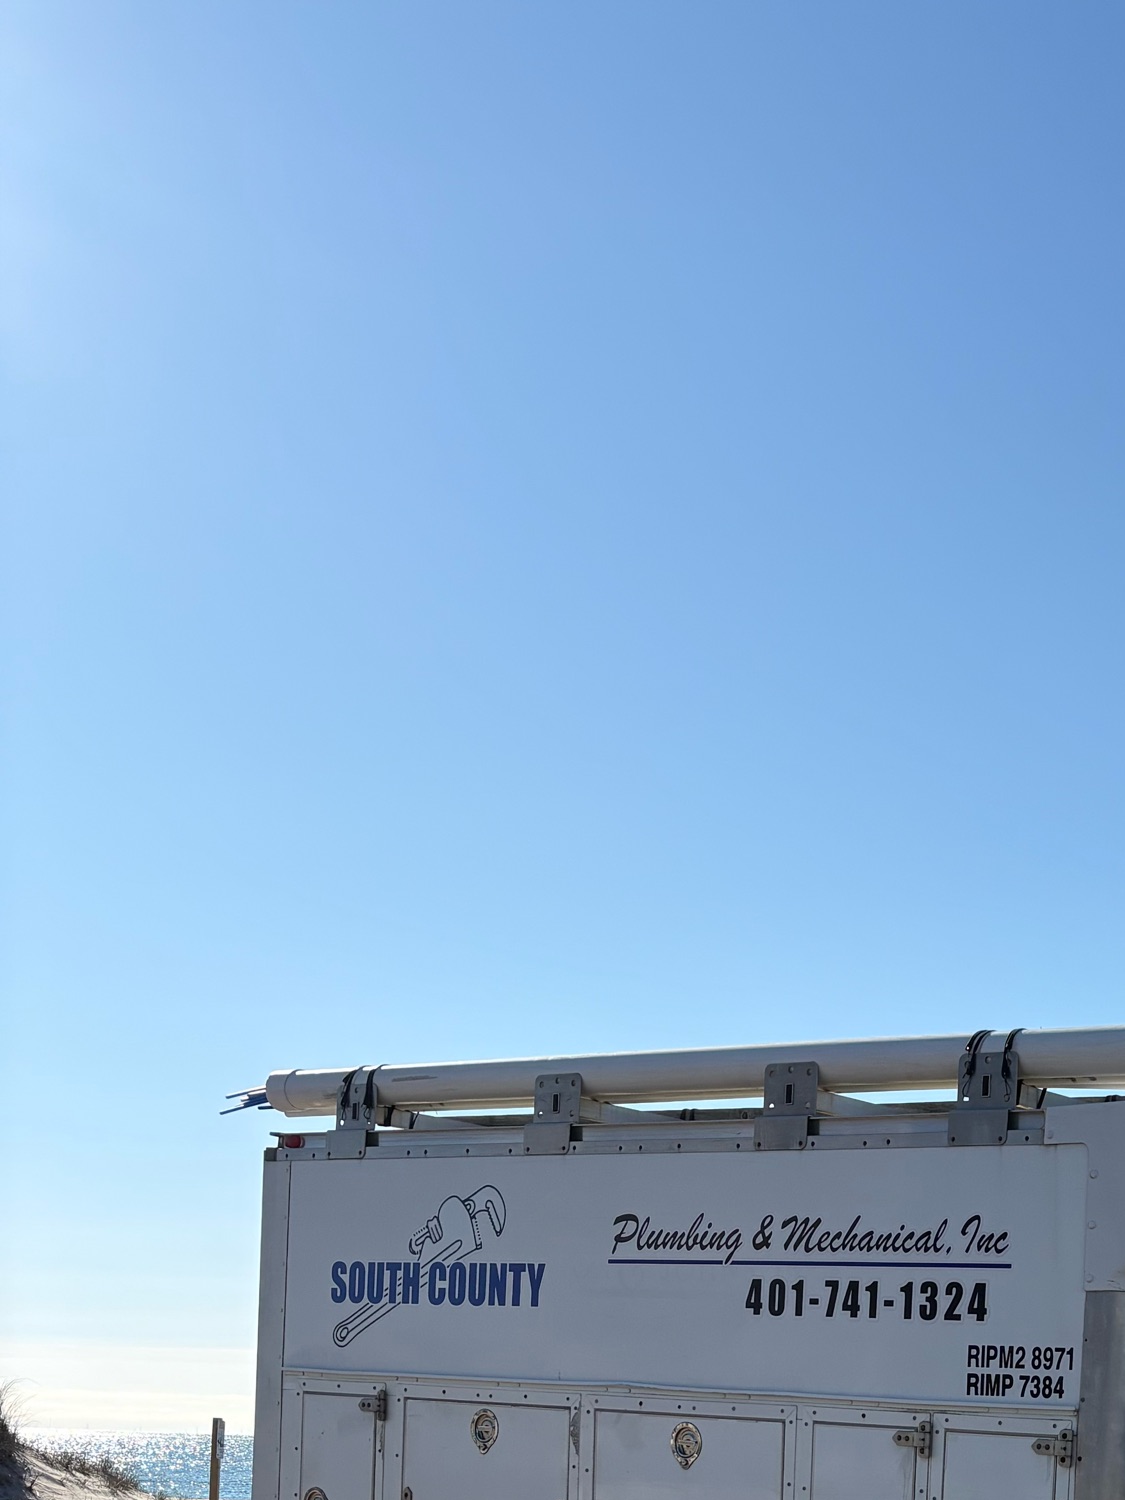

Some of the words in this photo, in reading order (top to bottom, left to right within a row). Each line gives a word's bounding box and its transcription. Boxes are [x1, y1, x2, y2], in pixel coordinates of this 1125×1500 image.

[612, 1213, 743, 1265] Plumbing
[752, 1214, 773, 1251] &
[781, 1214, 952, 1257] Mechanical,
[960, 1214, 1010, 1255] Inc
[331, 1261, 420, 1304] SOUTH
[428, 1261, 546, 1307] COUNTY
[745, 1278, 988, 1322] 401-741-1324
[967, 1345, 1026, 1370] RIPM2
[1031, 1346, 1075, 1371] 8971
[966, 1373, 1014, 1397] RIMP
[1019, 1375, 1065, 1399] 7384
